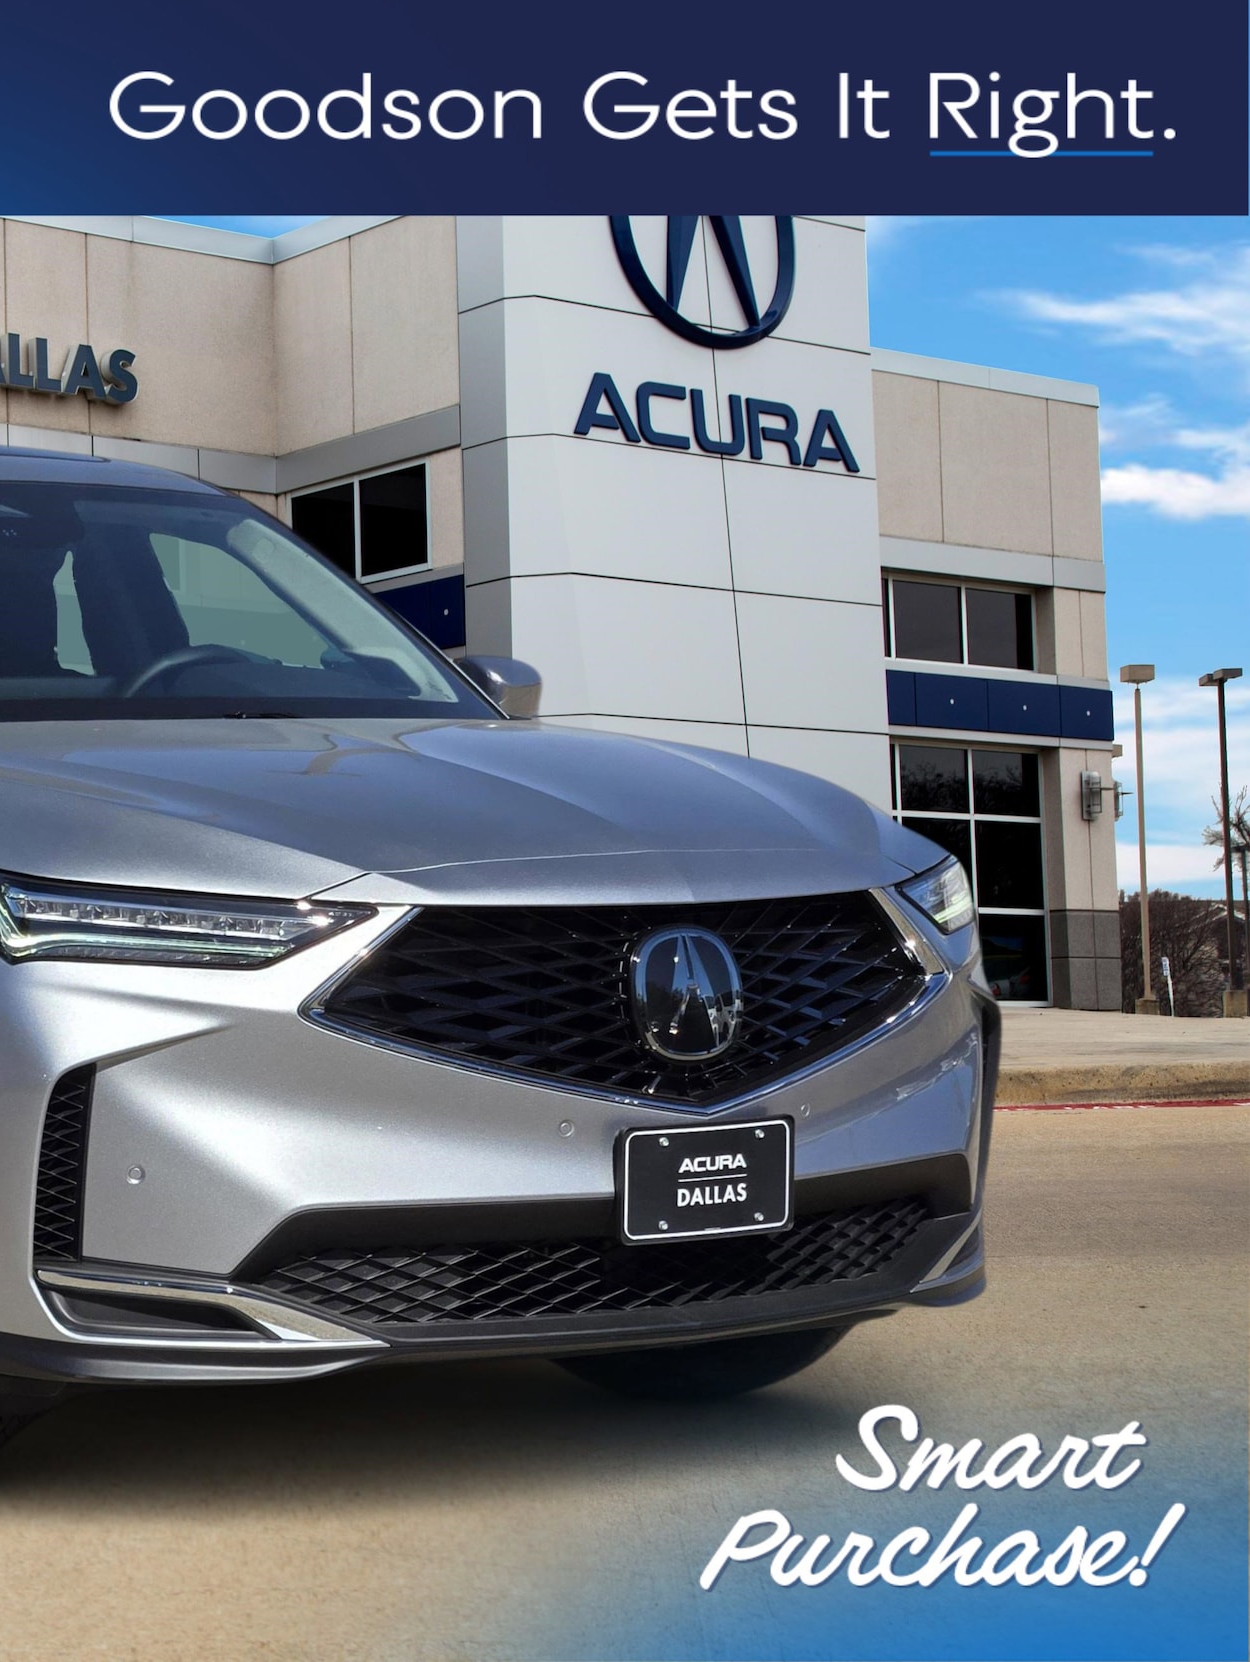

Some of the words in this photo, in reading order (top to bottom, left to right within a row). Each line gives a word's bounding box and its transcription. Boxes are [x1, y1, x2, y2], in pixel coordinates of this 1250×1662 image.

[573, 371, 861, 473] ACURA
[678, 1153, 748, 1174] ACURA
[676, 1182, 748, 1208] DALLAS
